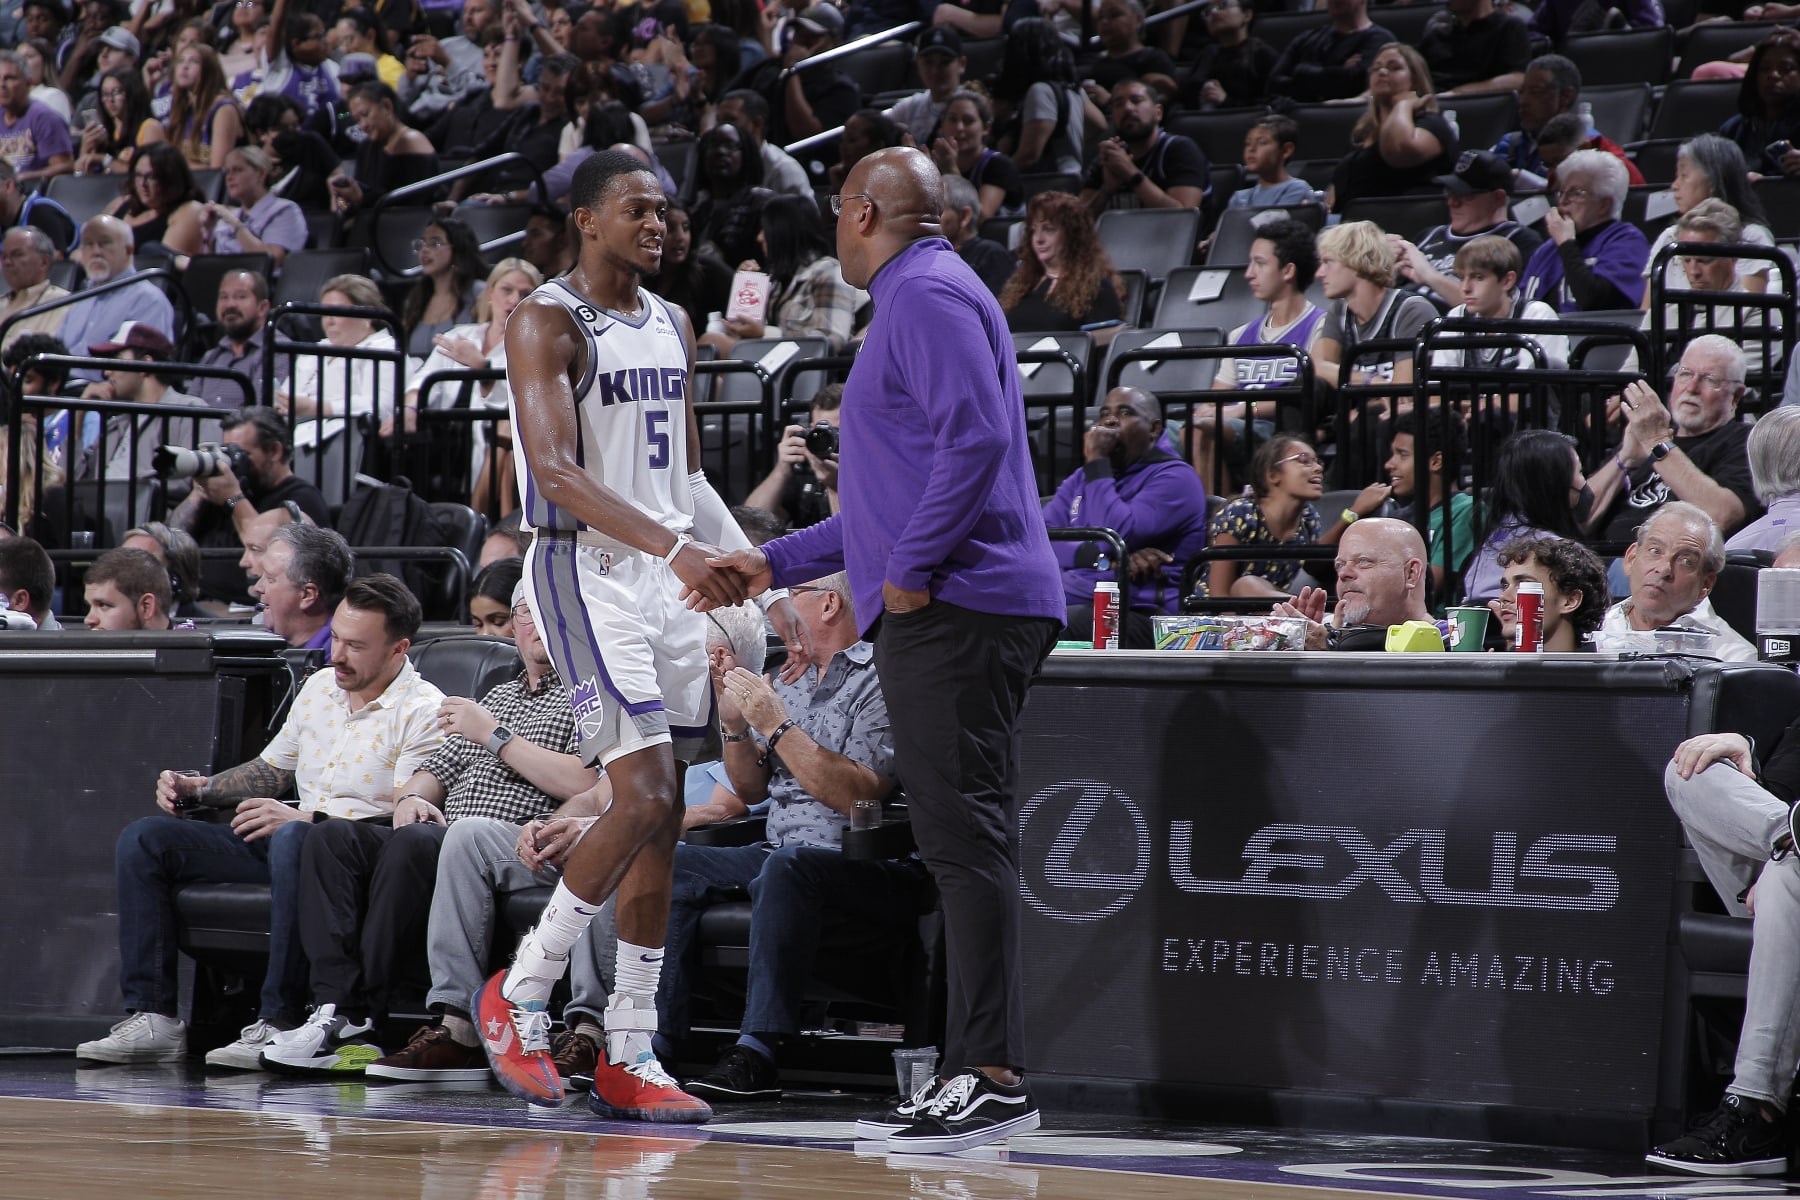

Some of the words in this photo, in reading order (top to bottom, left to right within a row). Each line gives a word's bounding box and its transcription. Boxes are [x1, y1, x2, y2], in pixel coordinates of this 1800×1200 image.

[577, 306, 595, 322] 6
[1236, 358, 1298, 382] SAC
[645, 410, 670, 469] 5
[574, 697, 601, 721] SAC
[1168, 819, 1620, 911] LEXUS
[1162, 938, 1403, 984] EXPERIENCE
[1420, 951, 1616, 995] AMAZING
